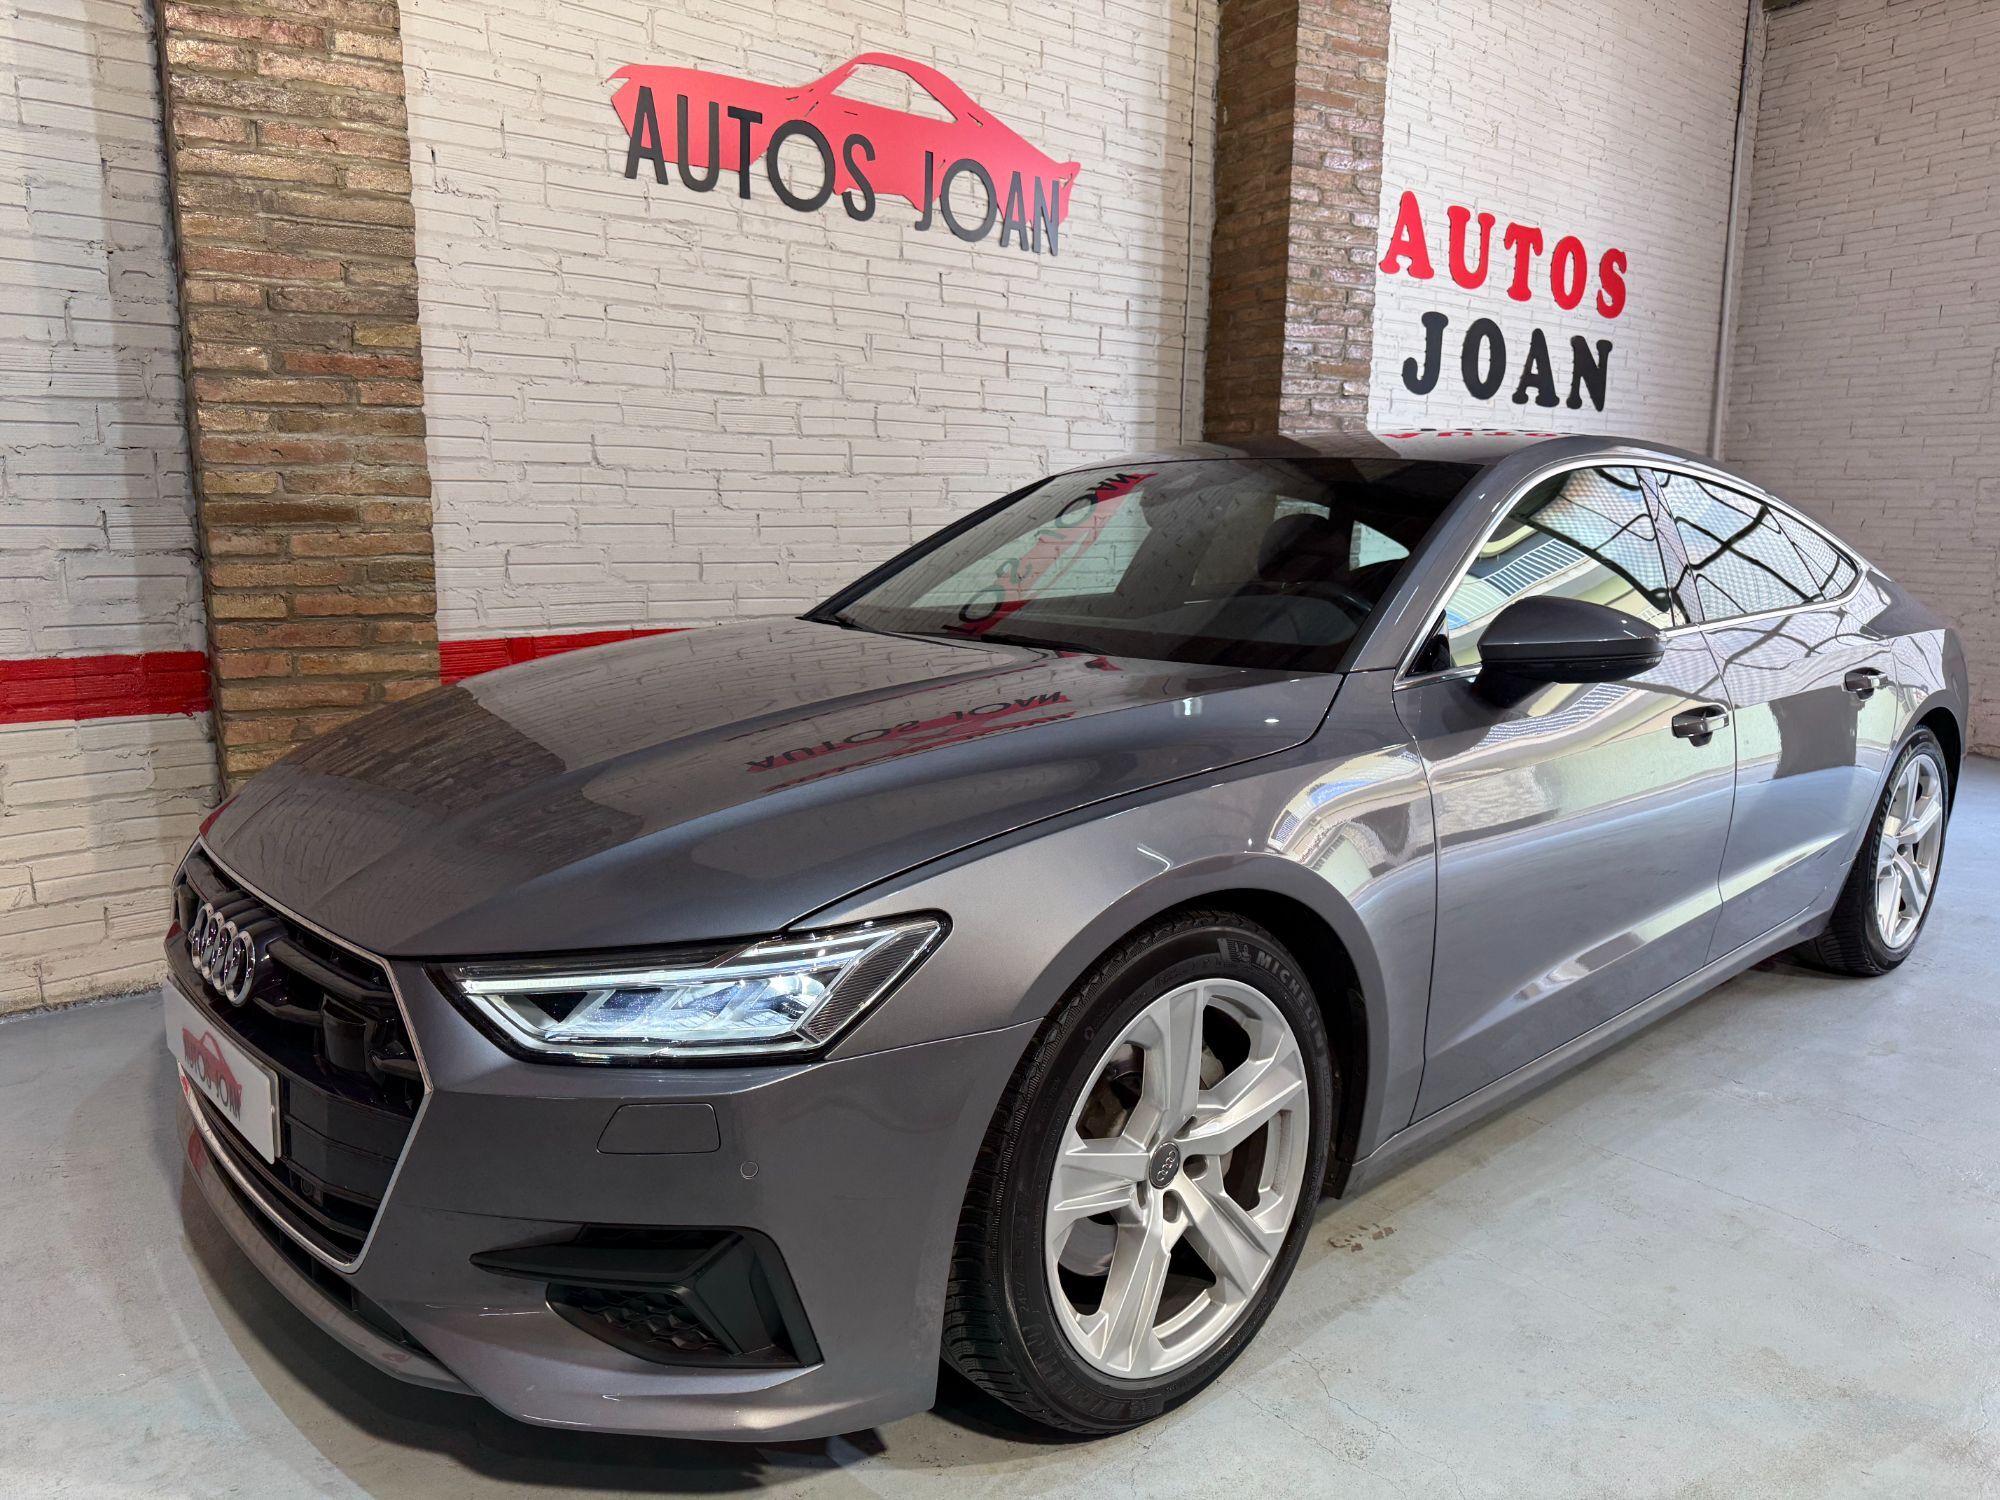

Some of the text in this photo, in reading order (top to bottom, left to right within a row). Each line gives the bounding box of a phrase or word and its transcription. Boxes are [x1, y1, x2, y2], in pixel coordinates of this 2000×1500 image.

[625, 85, 1060, 256] AUTOS JOAN
[1379, 190, 1627, 319] AUTOS
[1402, 311, 1613, 412] JOAN
[1256, 950, 1324, 1049] MICHELIN
